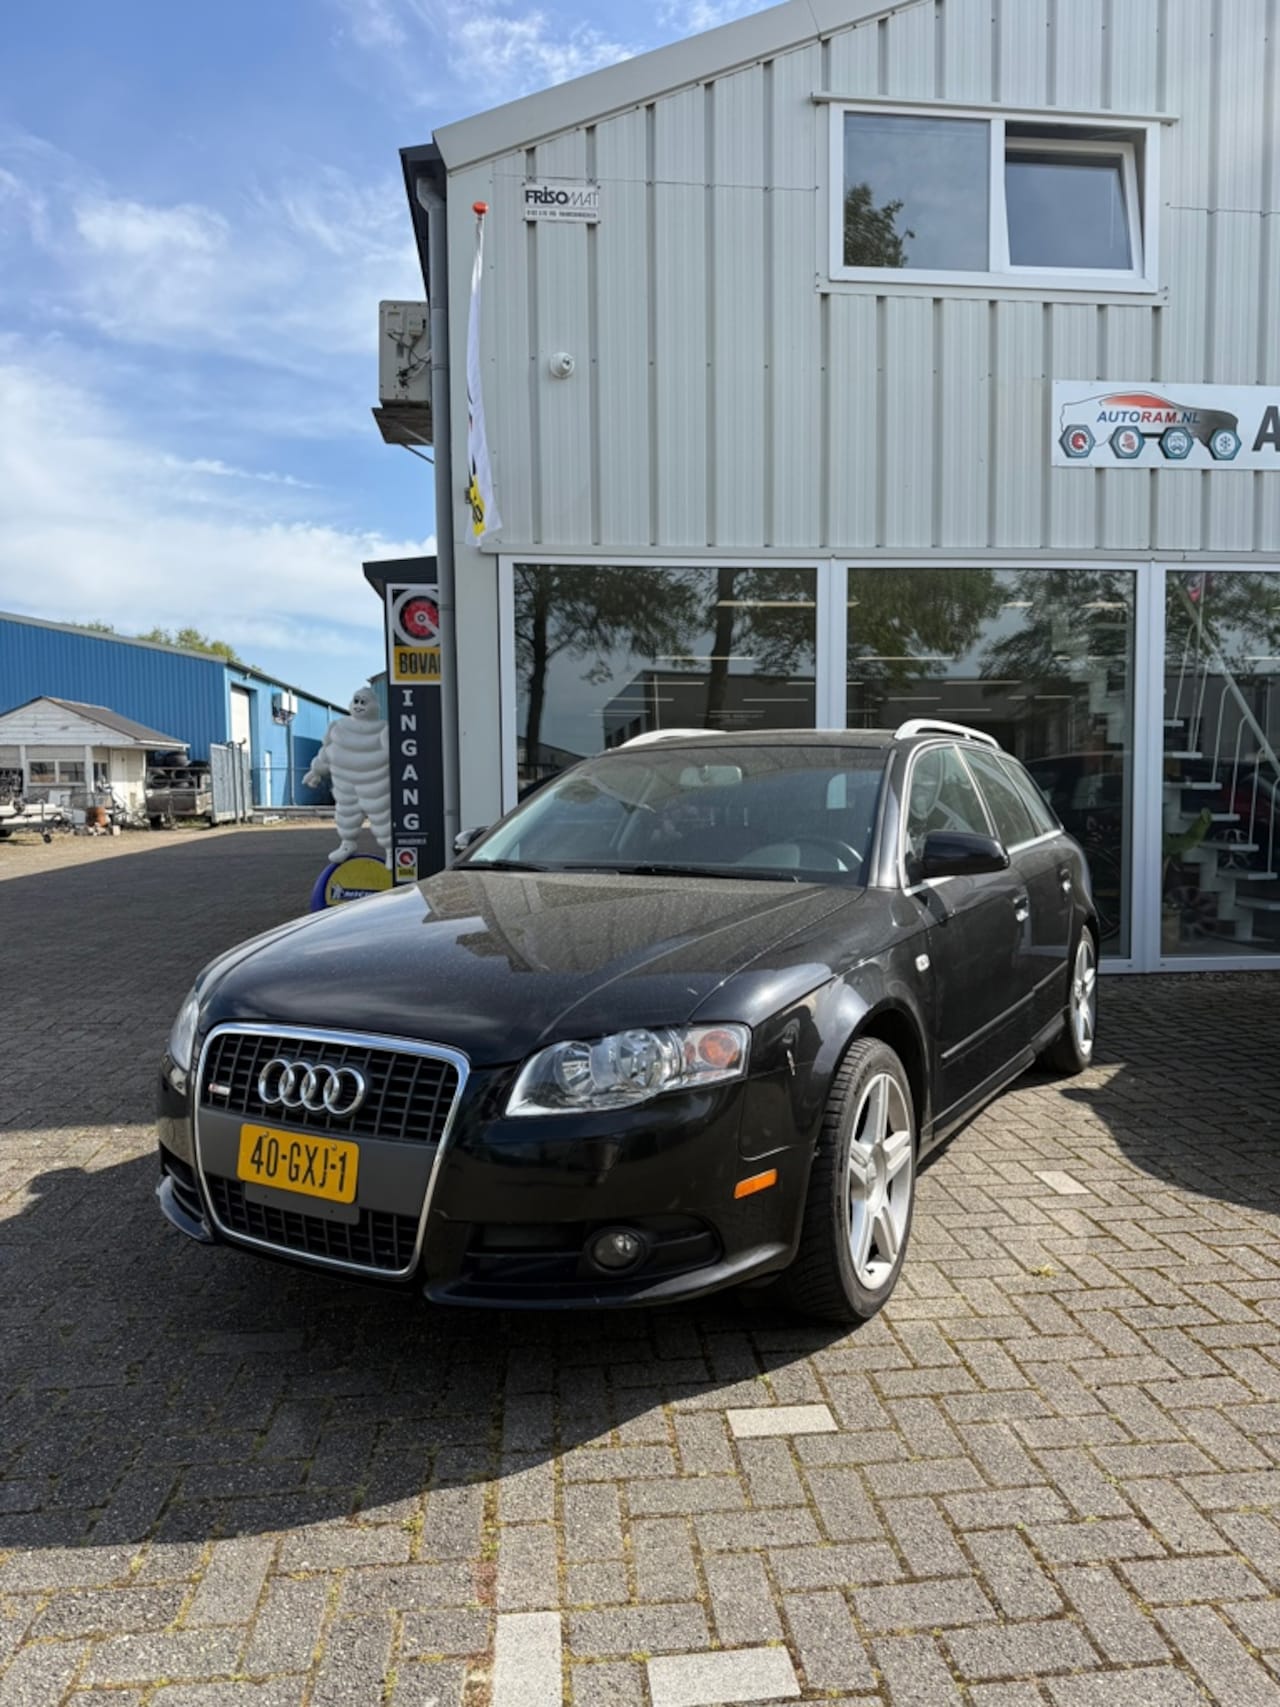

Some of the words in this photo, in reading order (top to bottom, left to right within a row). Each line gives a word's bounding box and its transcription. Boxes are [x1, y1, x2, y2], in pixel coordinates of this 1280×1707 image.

[1097, 410, 1200, 424] AUTORAM.NL
[399, 652, 440, 674] BOVA
[400, 690, 420, 830] INGANG
[250, 1135, 347, 1193] 40-GXJ-1
